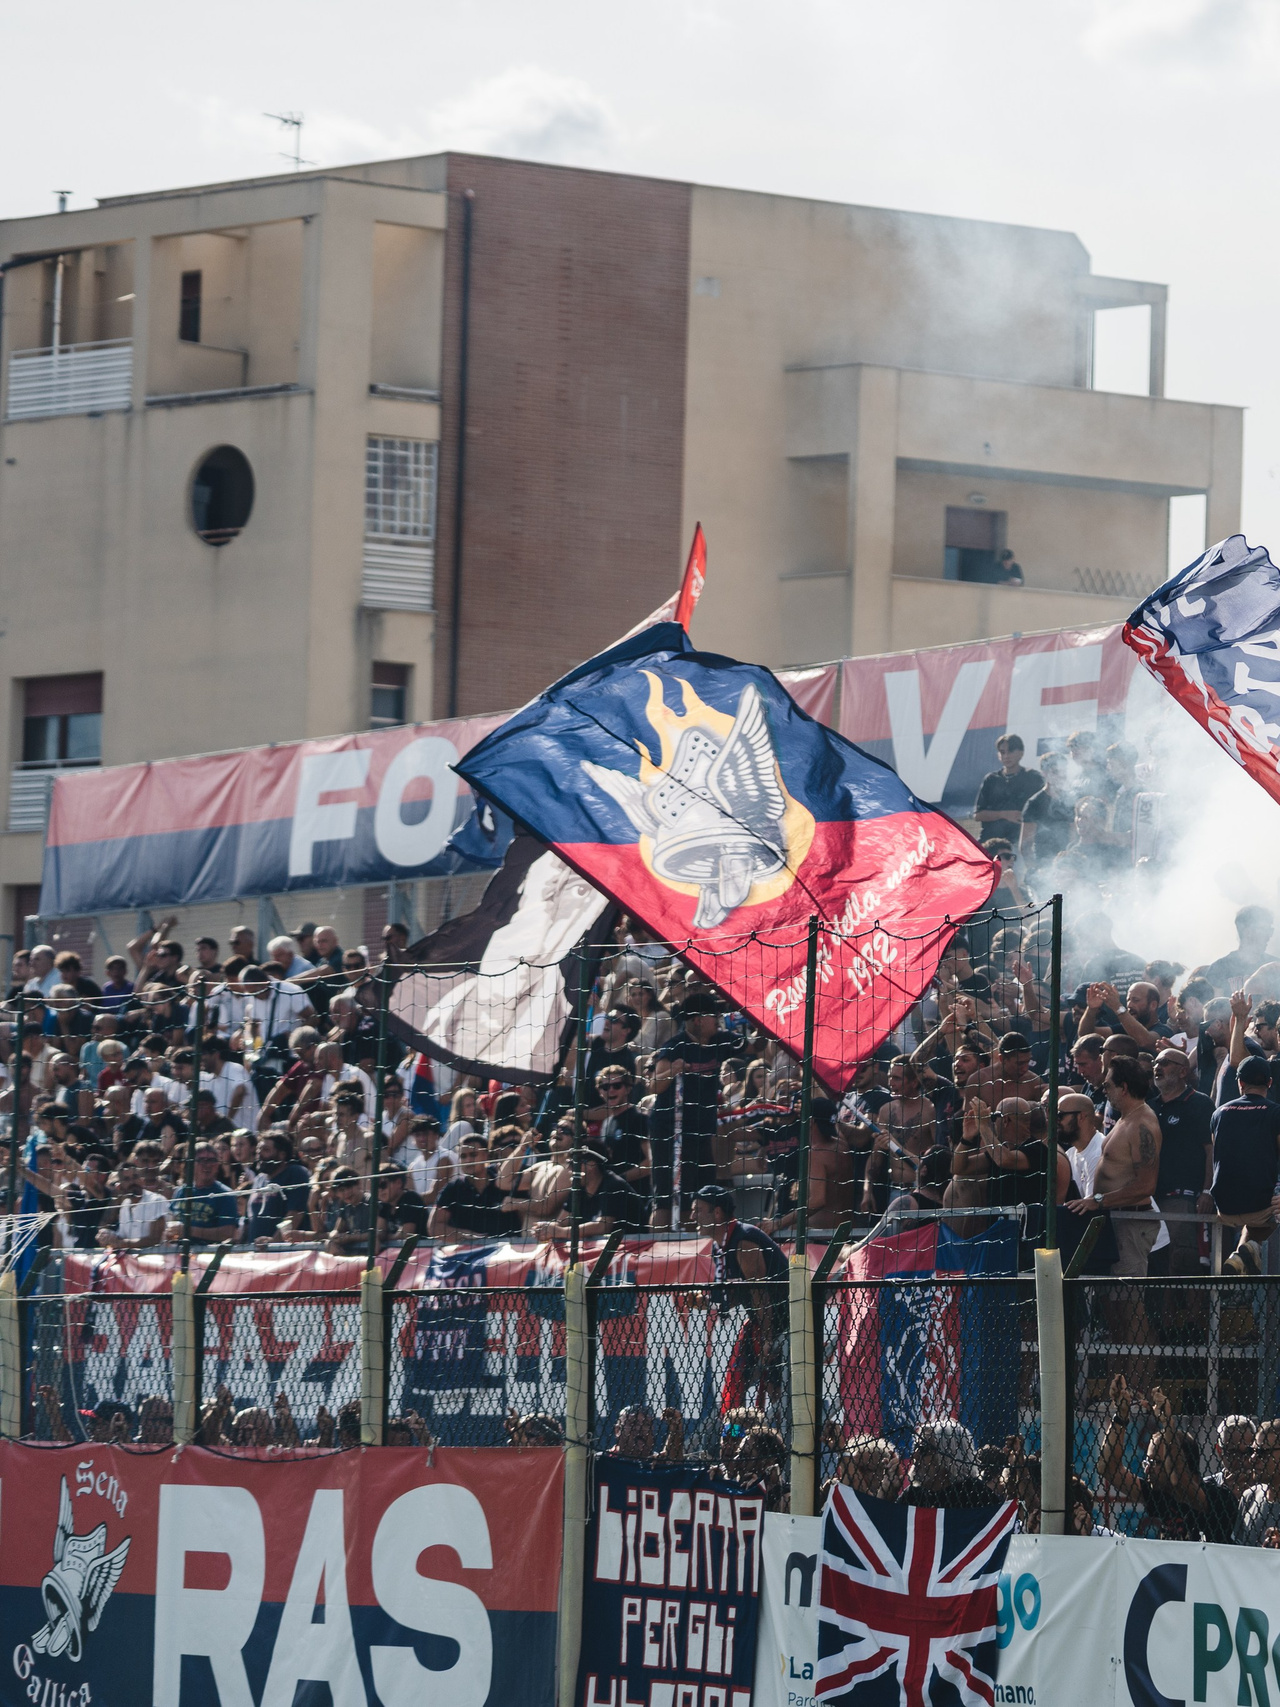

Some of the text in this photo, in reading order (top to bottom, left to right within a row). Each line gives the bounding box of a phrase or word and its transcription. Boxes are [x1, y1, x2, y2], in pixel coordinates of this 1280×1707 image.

[887, 826, 936, 889] nord
[848, 932, 897, 996] 1982
[75, 1459, 129, 1519] Sena
[621, 1596, 680, 1670] PER
